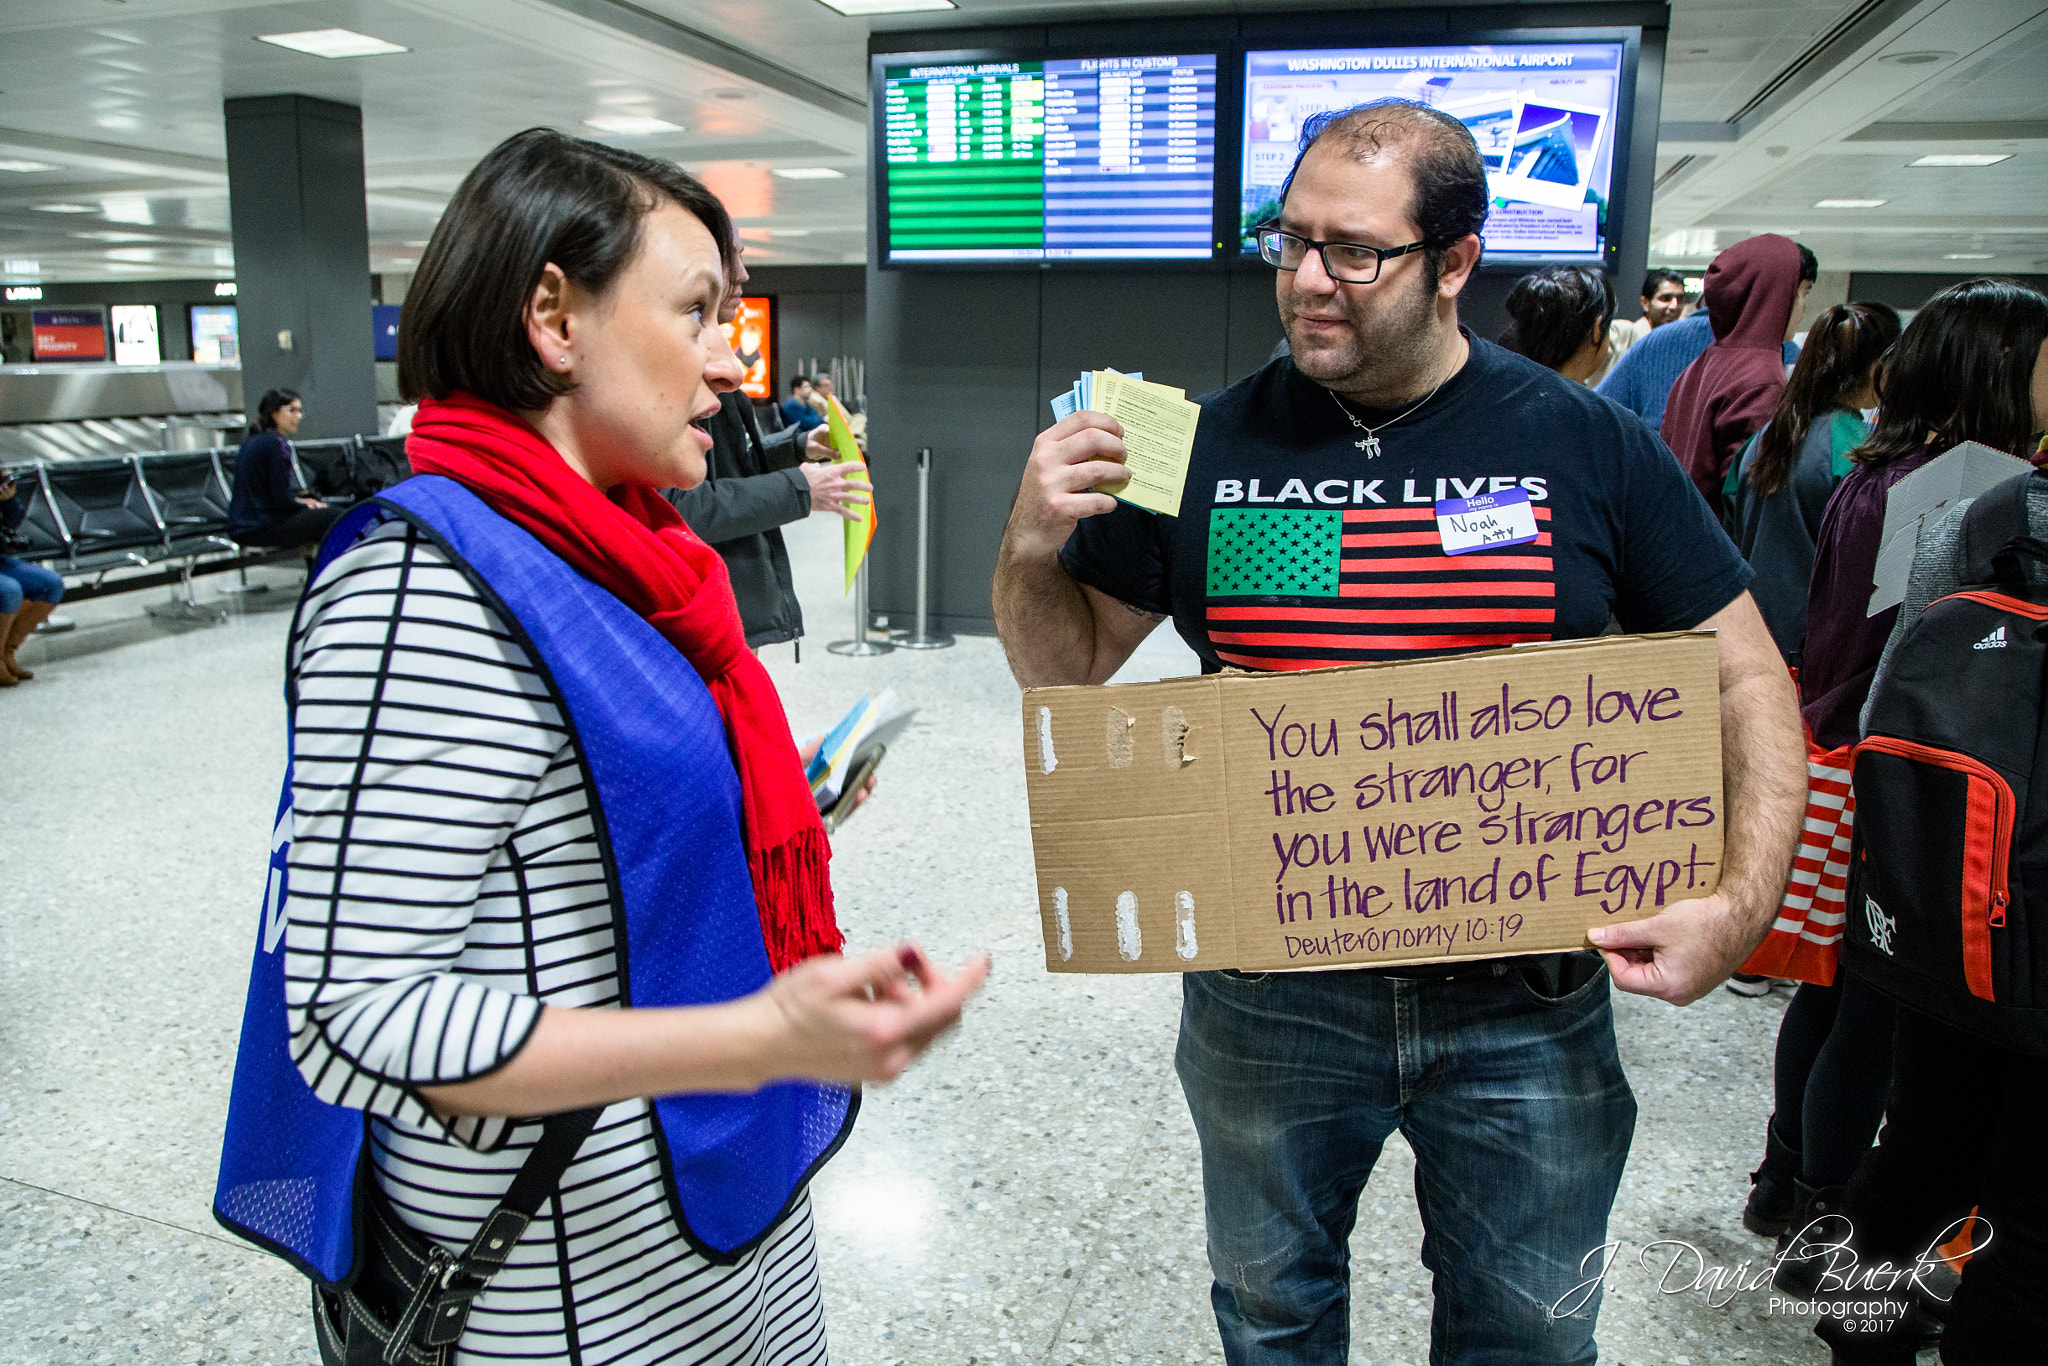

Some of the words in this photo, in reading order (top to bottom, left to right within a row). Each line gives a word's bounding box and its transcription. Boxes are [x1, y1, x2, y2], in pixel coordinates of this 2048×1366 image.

[910, 65, 975, 77] INTERNATIONAL
[977, 63, 1020, 74] ARRIVALS
[1121, 58, 1130, 68] IN
[1132, 57, 1178, 68] CUSTOMS
[1288, 58, 1371, 72] WASHINGTON
[1373, 56, 1417, 70] DULLES
[1419, 54, 1517, 69] INTERNATIONAL
[1519, 52, 1575, 67] AIRPORT
[1256, 152, 1277, 160] STEP
[1214, 478, 1387, 504] BLACK
[1404, 476, 1549, 504] LIVES
[1466, 496, 1494, 508] Hello
[1450, 514, 1498, 532] Noah
[1973, 641, 2008, 650] adidas
[1250, 704, 1338, 760] You
[1360, 691, 1459, 750] shall
[1470, 682, 1572, 740] also
[1587, 674, 1684, 728] love
[1265, 769, 1335, 816] the
[1570, 742, 1648, 792] for
[1272, 828, 1350, 884] you
[1364, 820, 1463, 863] were
[1482, 795, 1716, 854] strangers
[1276, 884, 1312, 925] in
[1320, 874, 1393, 918] the
[1404, 857, 1501, 914] land
[1508, 854, 1562, 901] of
[1574, 843, 1717, 915] Egypt.
[1285, 920, 1460, 959] Deuteronomy
[1465, 913, 1523, 942] 10:19
